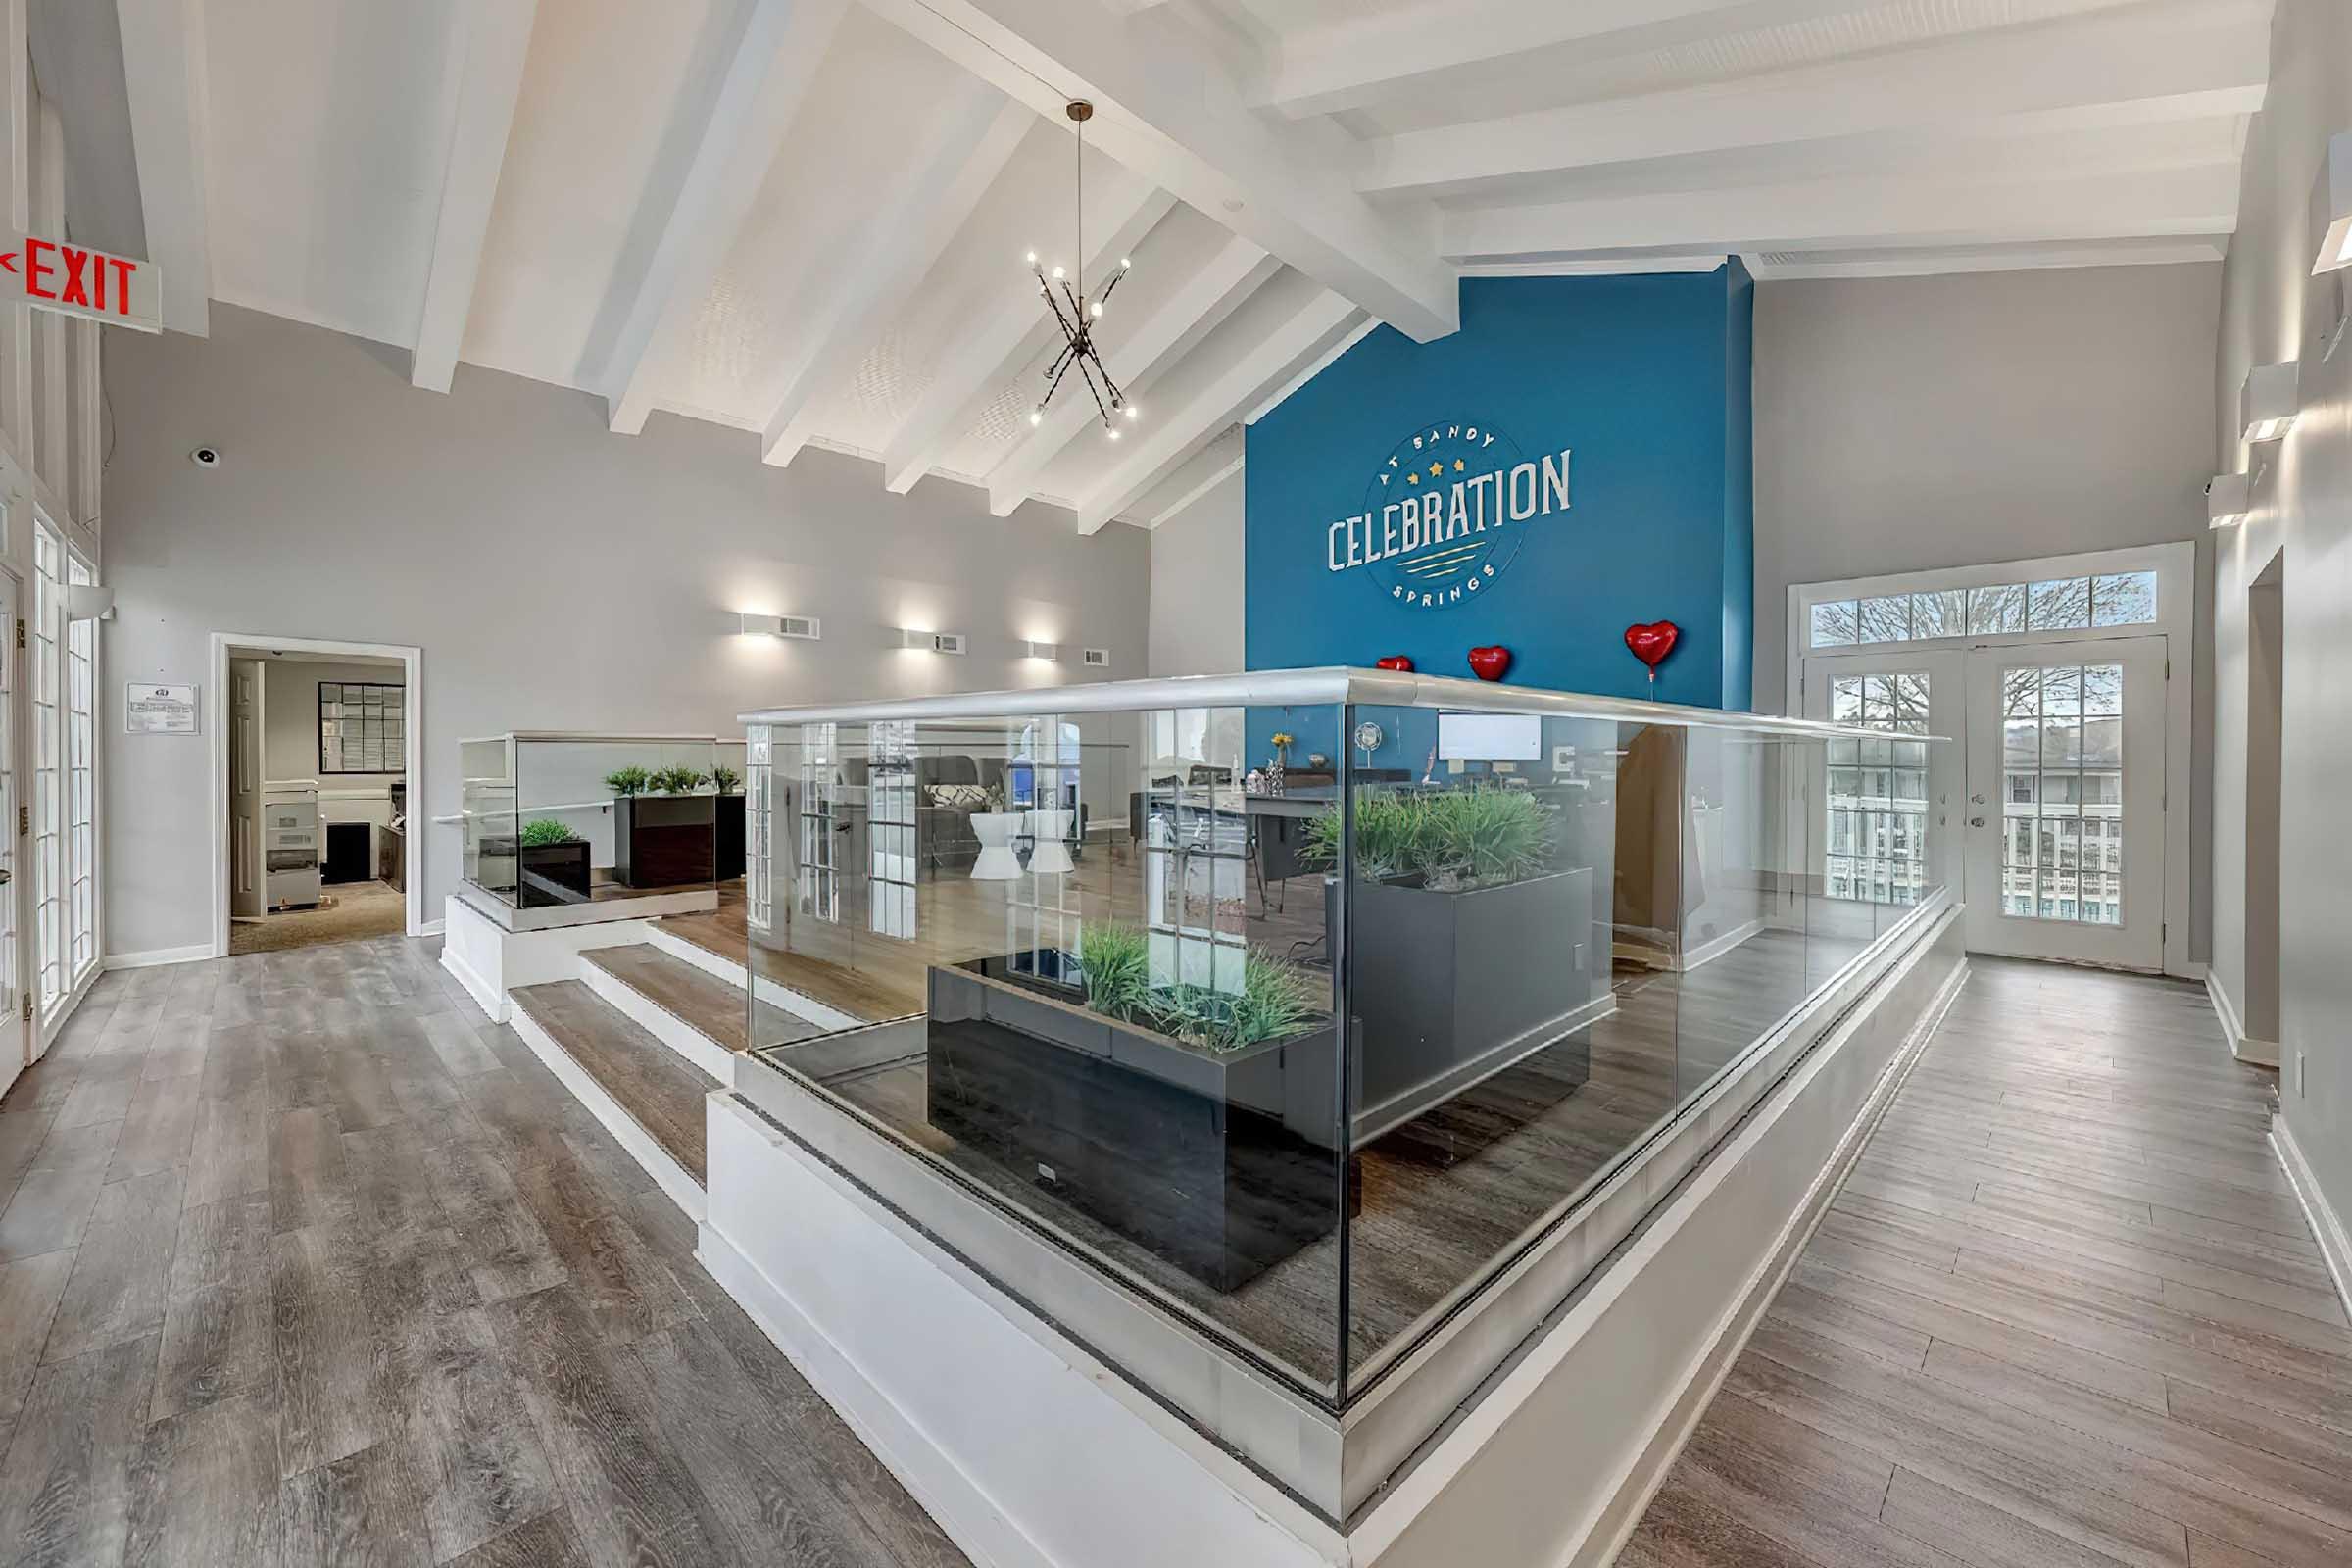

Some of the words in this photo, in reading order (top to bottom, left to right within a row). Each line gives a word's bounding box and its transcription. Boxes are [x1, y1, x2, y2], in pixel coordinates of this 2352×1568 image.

[26, 238, 137, 315] EXIT
[1379, 455, 1398, 486] AT
[1412, 425, 1494, 449] SANDY
[1328, 449, 1571, 572] CELEBRATION
[1393, 564, 1494, 607] SPRINGS
